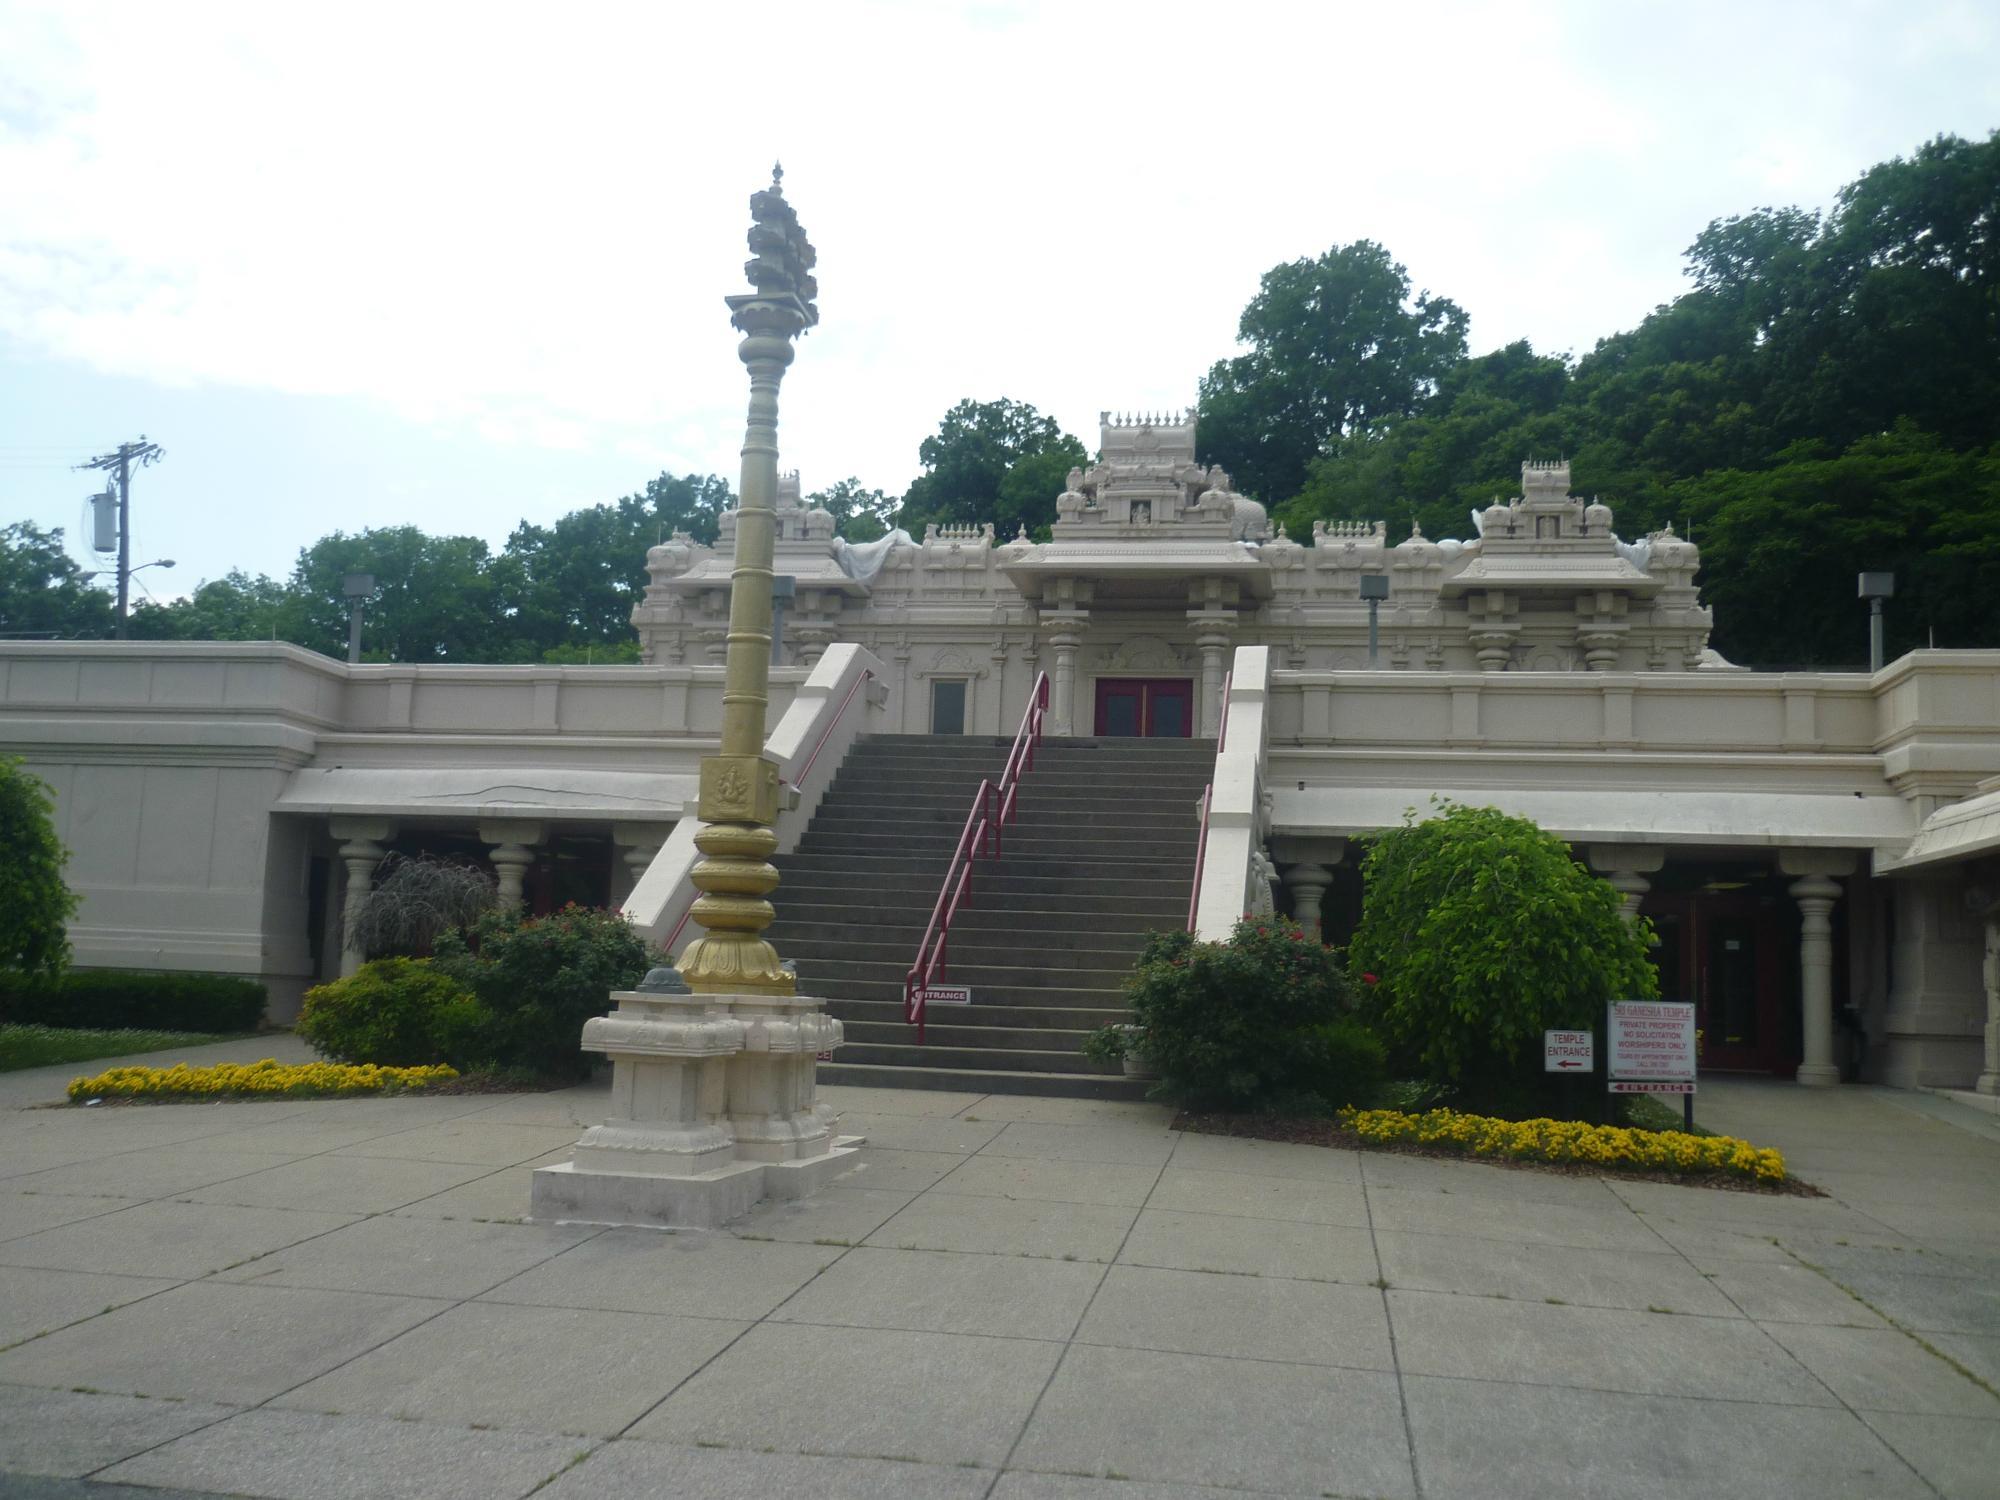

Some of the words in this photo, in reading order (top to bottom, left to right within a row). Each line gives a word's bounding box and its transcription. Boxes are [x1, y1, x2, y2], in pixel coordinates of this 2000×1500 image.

[1627, 1005, 1662, 1017] GANESHA
[1663, 1006, 1691, 1018] TEMPLE
[1648, 1022, 1685, 1030] PROPERTY
[1554, 1034, 1584, 1043] TEMPLE
[1636, 1031, 1681, 1039] SOLICITATION
[1668, 1042, 1687, 1050] ONLY
[1548, 1046, 1590, 1056] ENTRANCE
